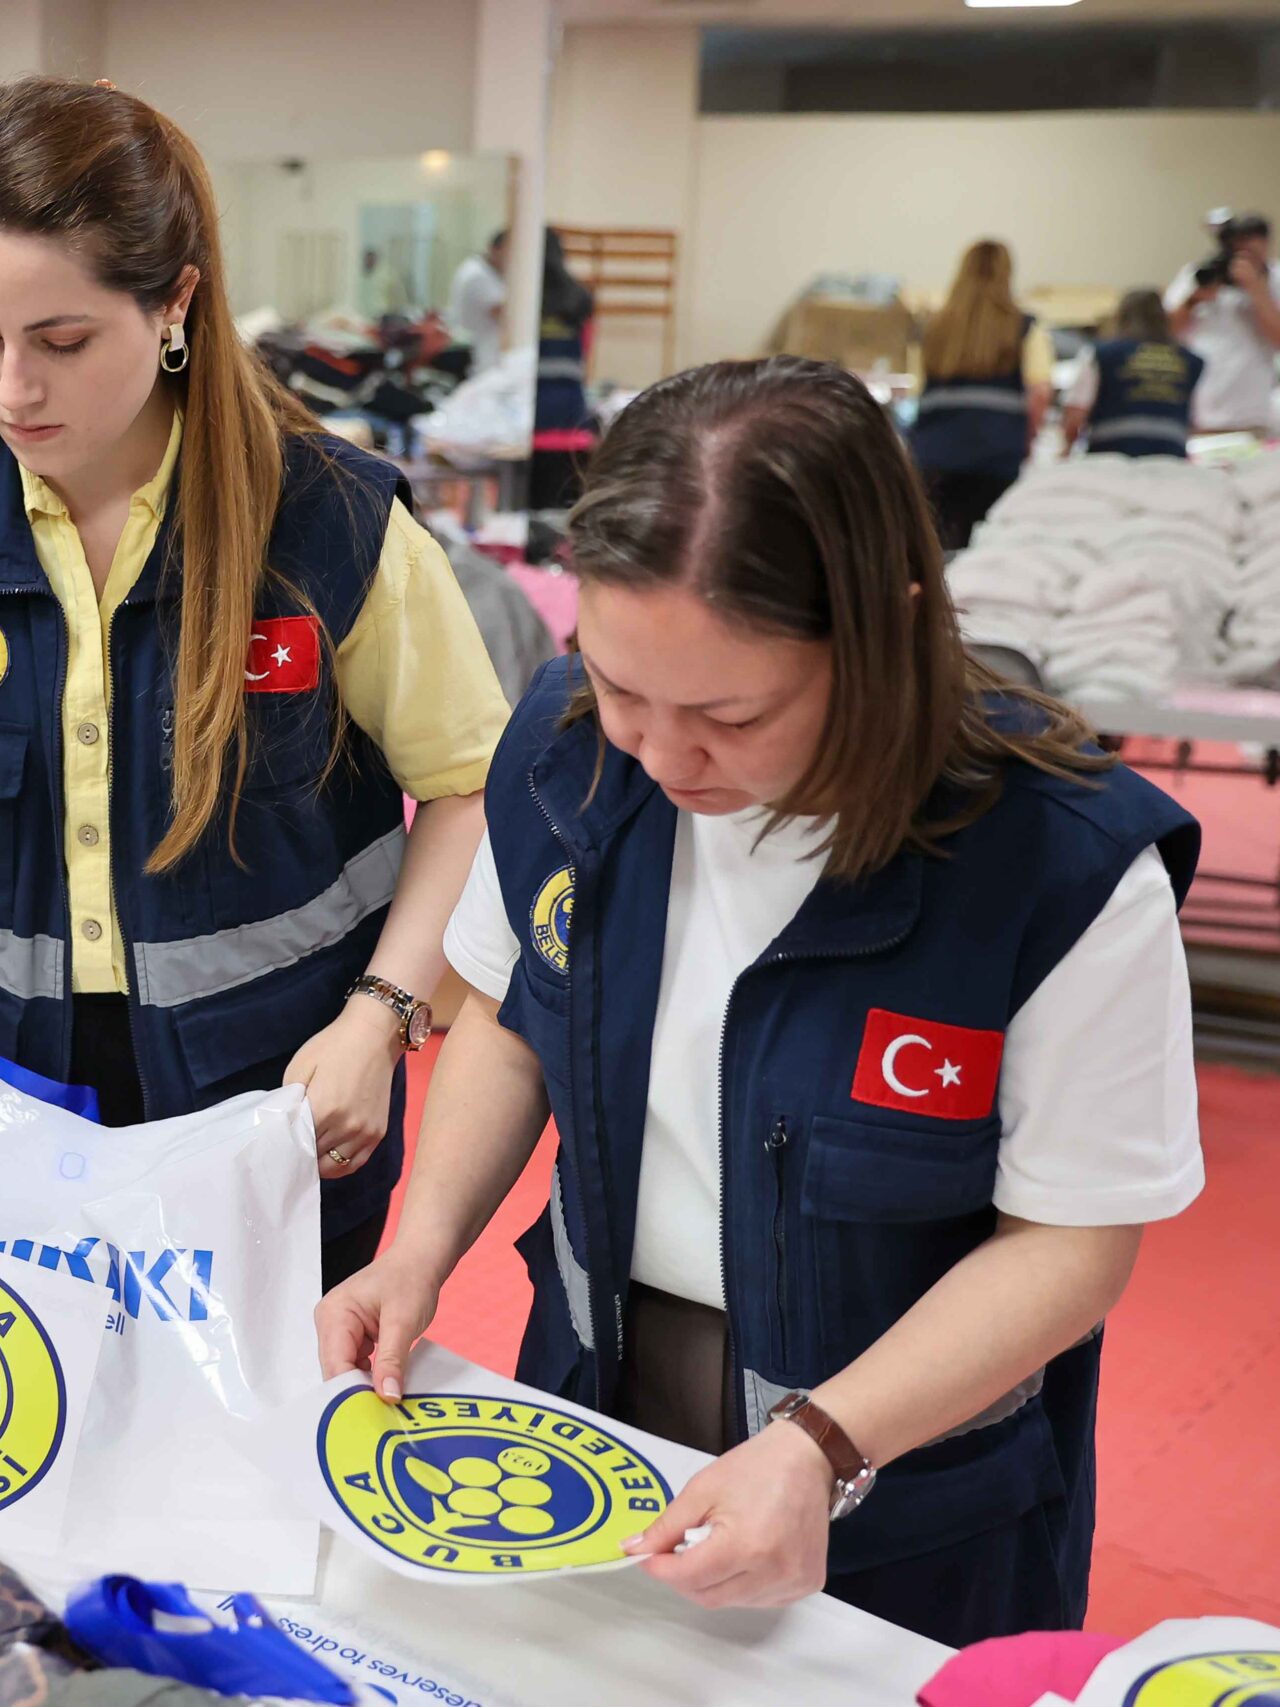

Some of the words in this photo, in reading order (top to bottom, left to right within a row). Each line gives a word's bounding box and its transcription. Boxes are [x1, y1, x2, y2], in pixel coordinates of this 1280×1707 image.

[104, 1311, 126, 1336] ell
[394, 1401, 671, 1513] BELEDİYESİ
[343, 1471, 524, 1568] BUCA
[339, 1647, 367, 1665] to
